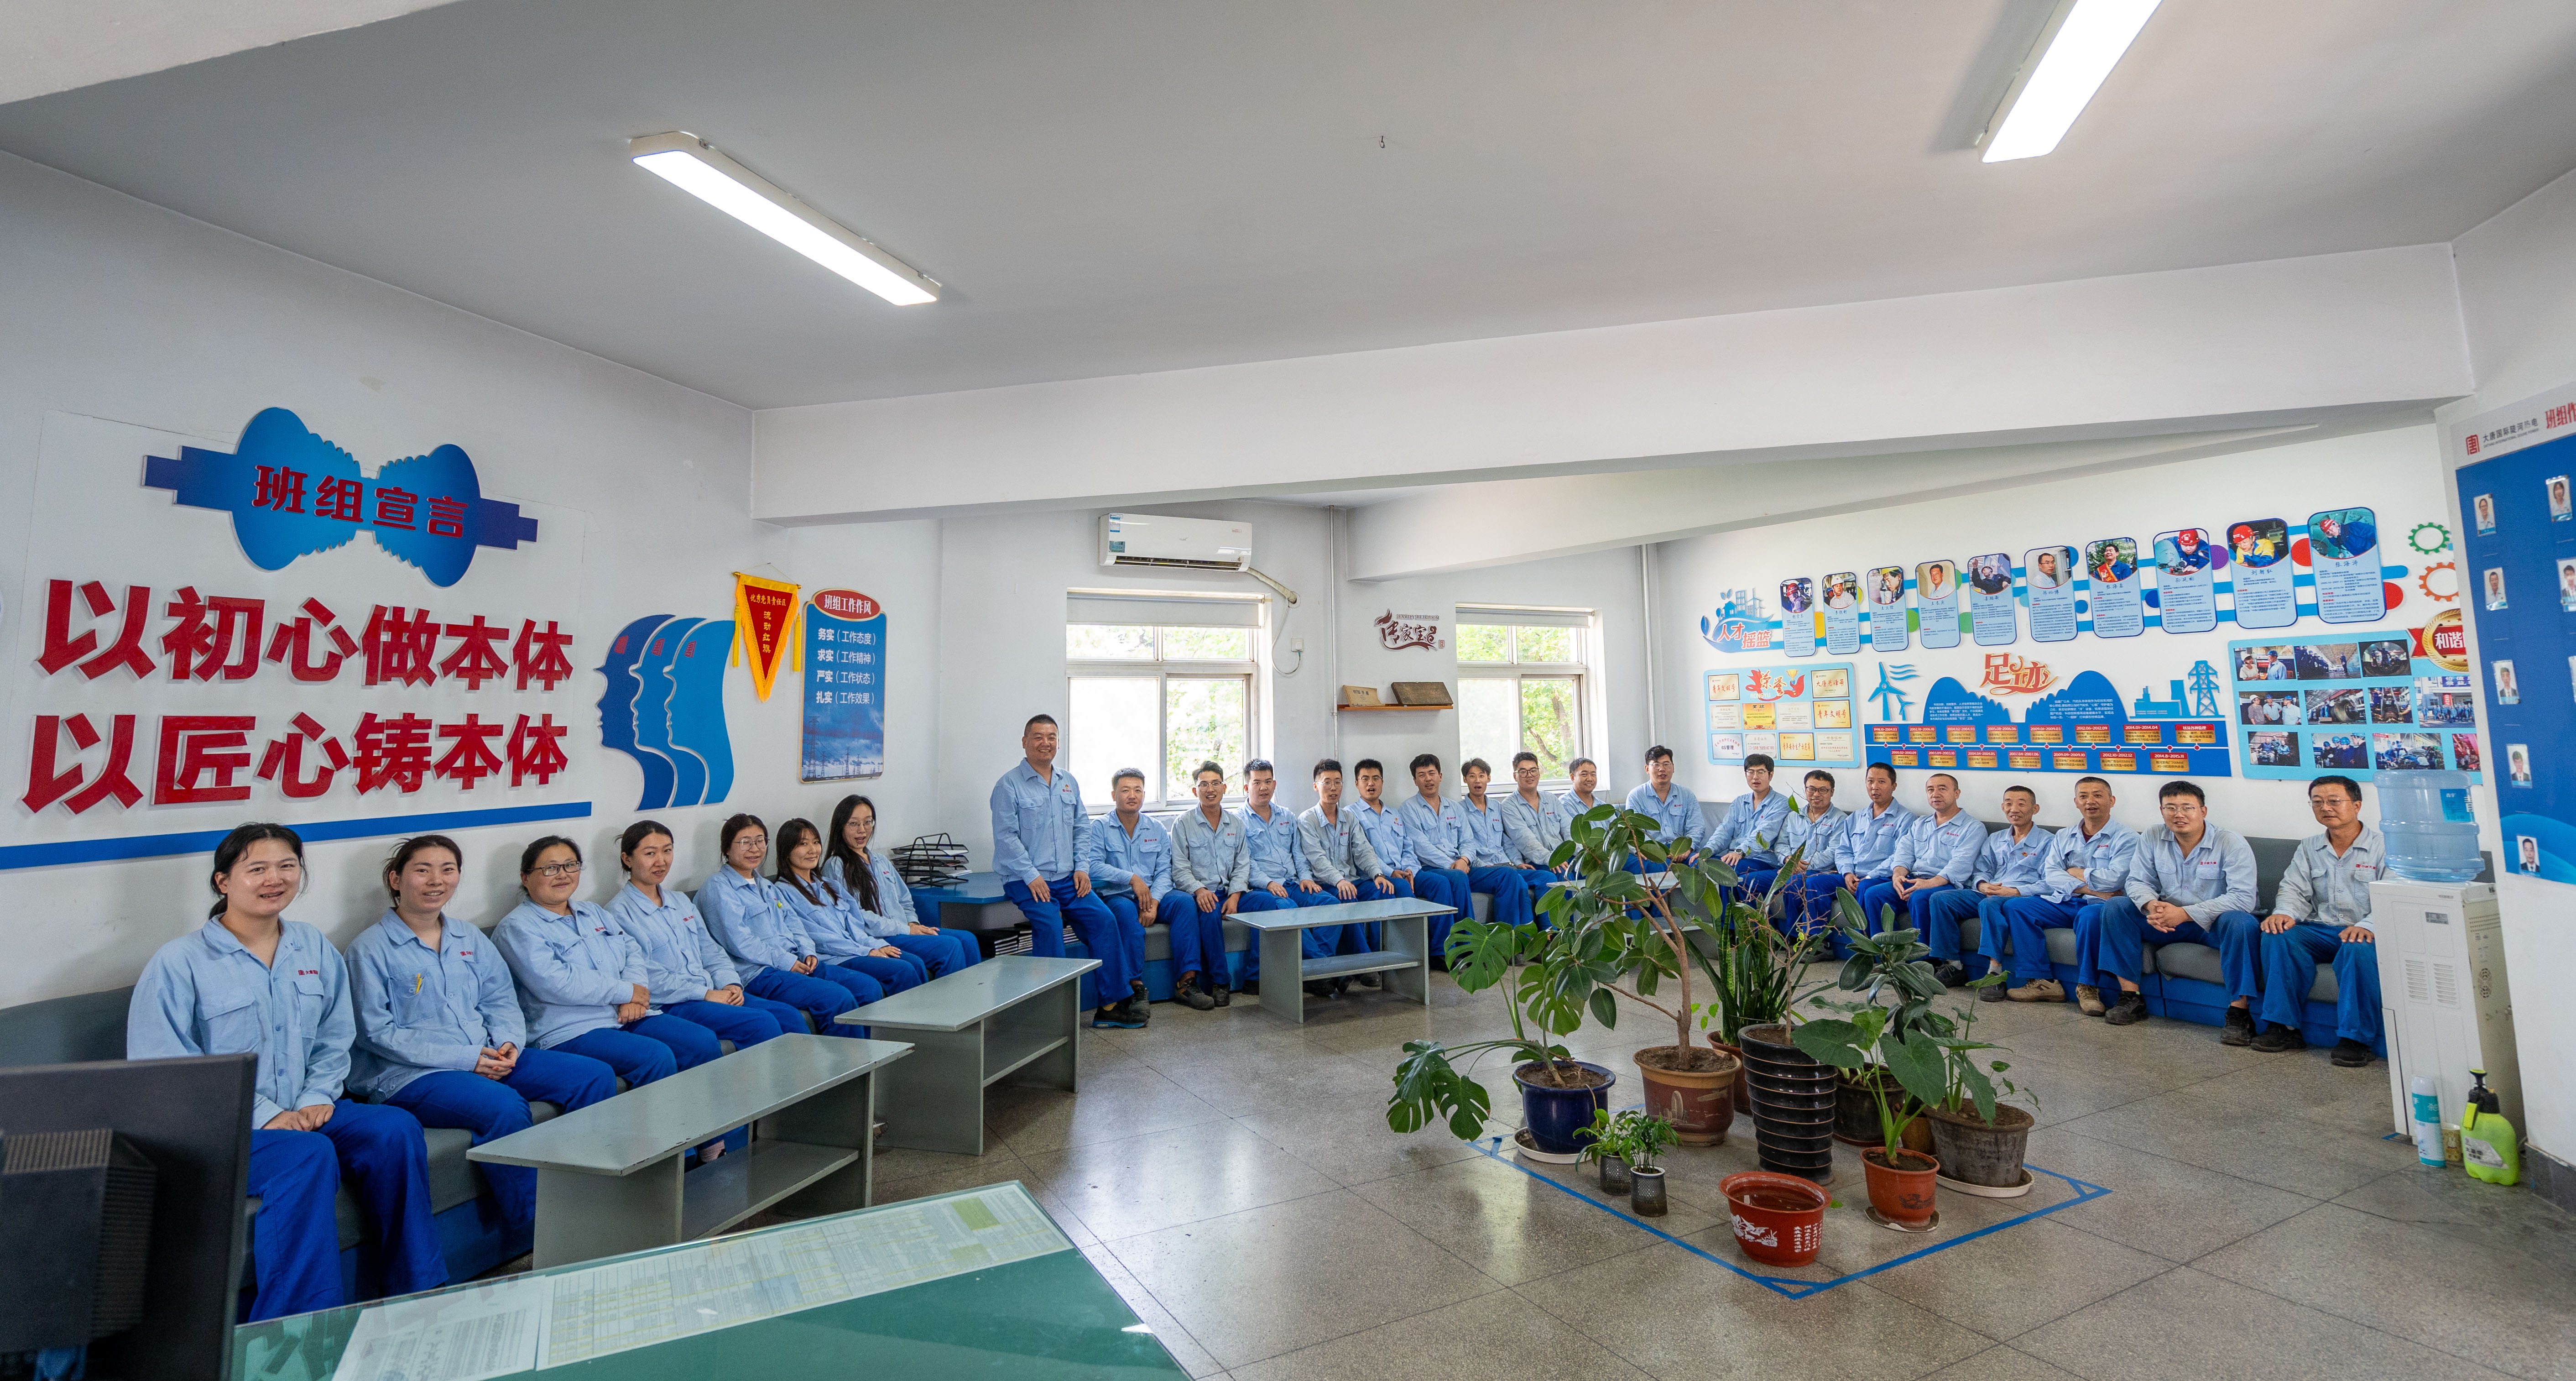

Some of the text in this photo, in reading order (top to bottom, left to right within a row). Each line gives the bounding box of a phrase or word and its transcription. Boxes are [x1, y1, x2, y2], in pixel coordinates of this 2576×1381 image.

[252, 465, 469, 539] 班组宣言
[750, 594, 786, 606] 优秀党员责任区
[824, 594, 872, 615] 班组工作作风
[36, 579, 574, 692] 以初心做本体
[762, 611, 772, 653] 流动红旗
[1381, 621, 1435, 644] 传家宝
[1718, 623, 1770, 648] 人才摇篮
[2435, 632, 2466, 649] 和谐
[1760, 670, 1787, 696] 荣誉
[1980, 653, 2053, 693] 足迹
[1818, 709, 1846, 719] 青年文明号
[22, 712, 569, 816] 以匠心铸本体
